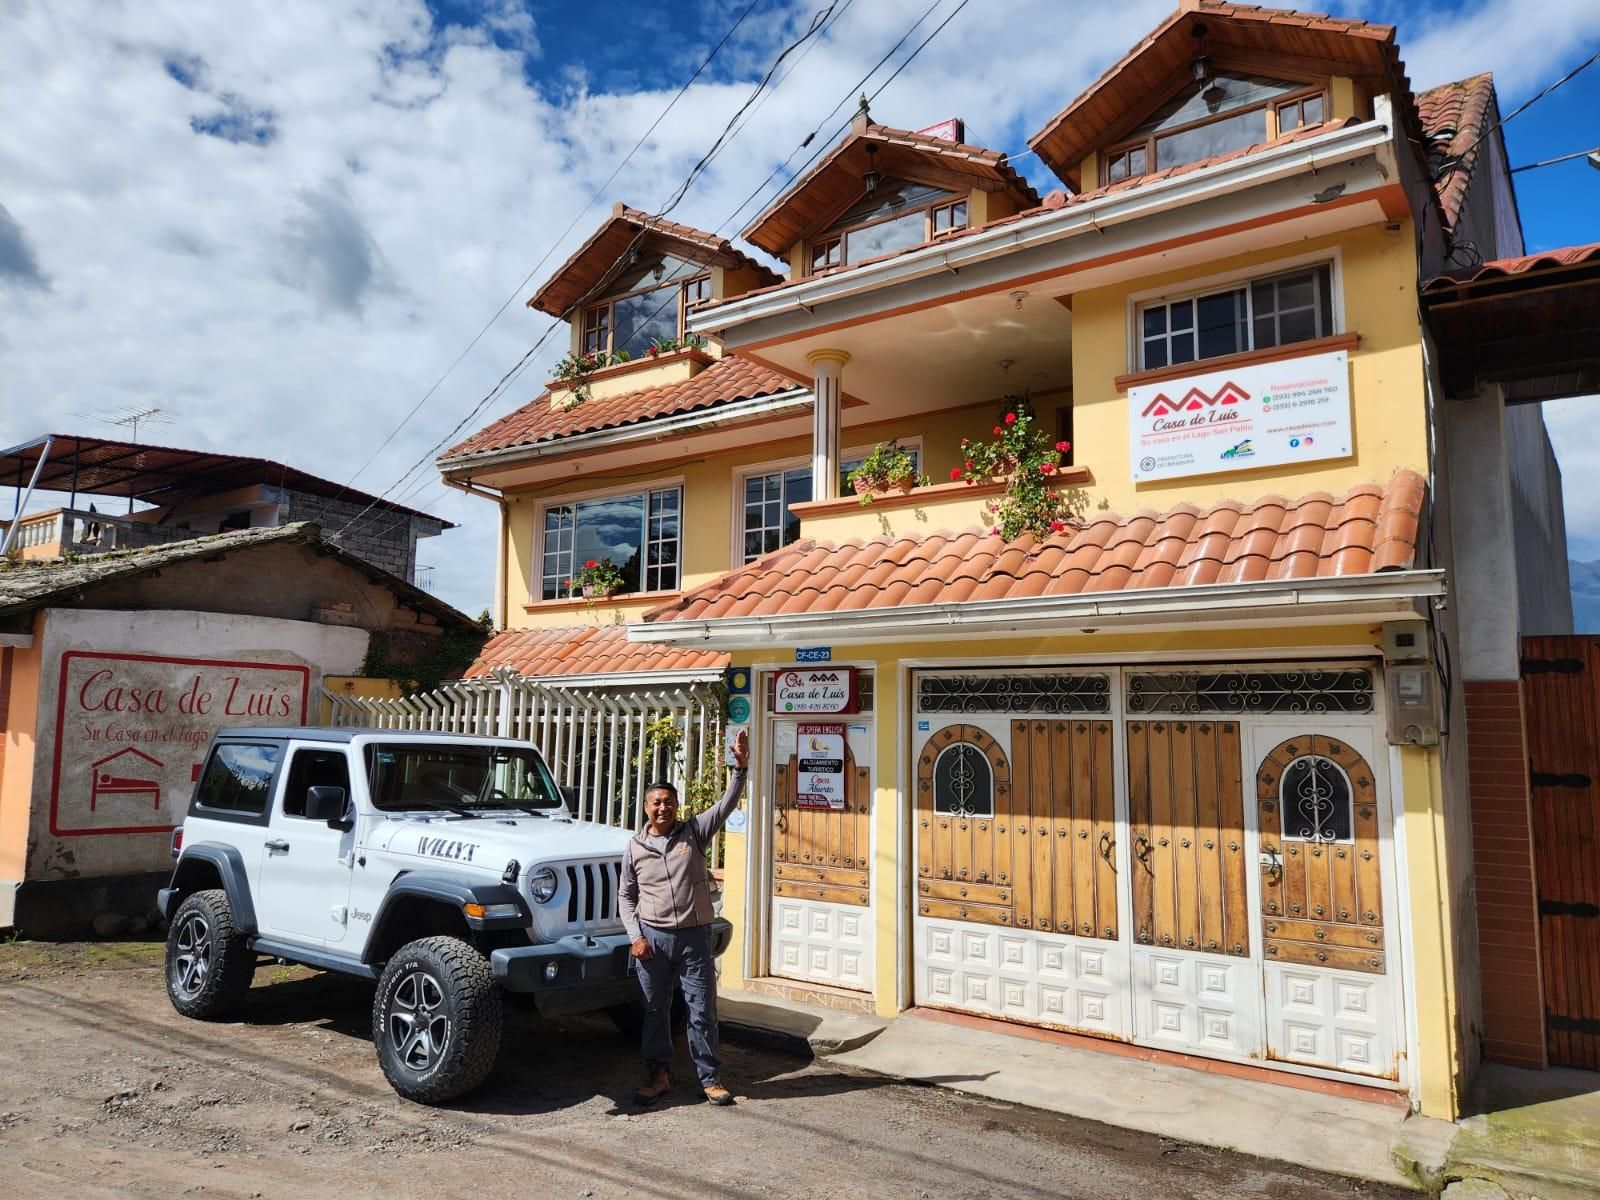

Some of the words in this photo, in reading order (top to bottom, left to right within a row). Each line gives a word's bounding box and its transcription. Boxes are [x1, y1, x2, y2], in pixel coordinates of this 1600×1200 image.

[1153, 419, 1186, 432] Casa
[1190, 413, 1206, 426] de
[1208, 409, 1239, 423] Luis
[1141, 439, 1152, 447] Su
[1152, 437, 1170, 445] casa
[1171, 435, 1181, 443] en
[1183, 433, 1190, 441] el
[1191, 430, 1212, 441] Lago
[1213, 427, 1229, 436] San
[1230, 424, 1253, 434] Pablo
[79, 669, 168, 714] Casa
[178, 675, 212, 715] de
[223, 676, 291, 717] Luis
[780, 687, 806, 700] Casa
[808, 687, 820, 699] de
[822, 686, 846, 699] Luis
[82, 721, 102, 742] Su
[105, 722, 141, 743] Casa
[143, 730, 158, 743] en
[161, 726, 173, 742] el
[806, 725, 822, 734] SPEAK
[822, 725, 844, 734] ENGLISH
[806, 783, 834, 793] Abierto
[811, 774, 830, 785] Open
[351, 907, 371, 924] Jeep
